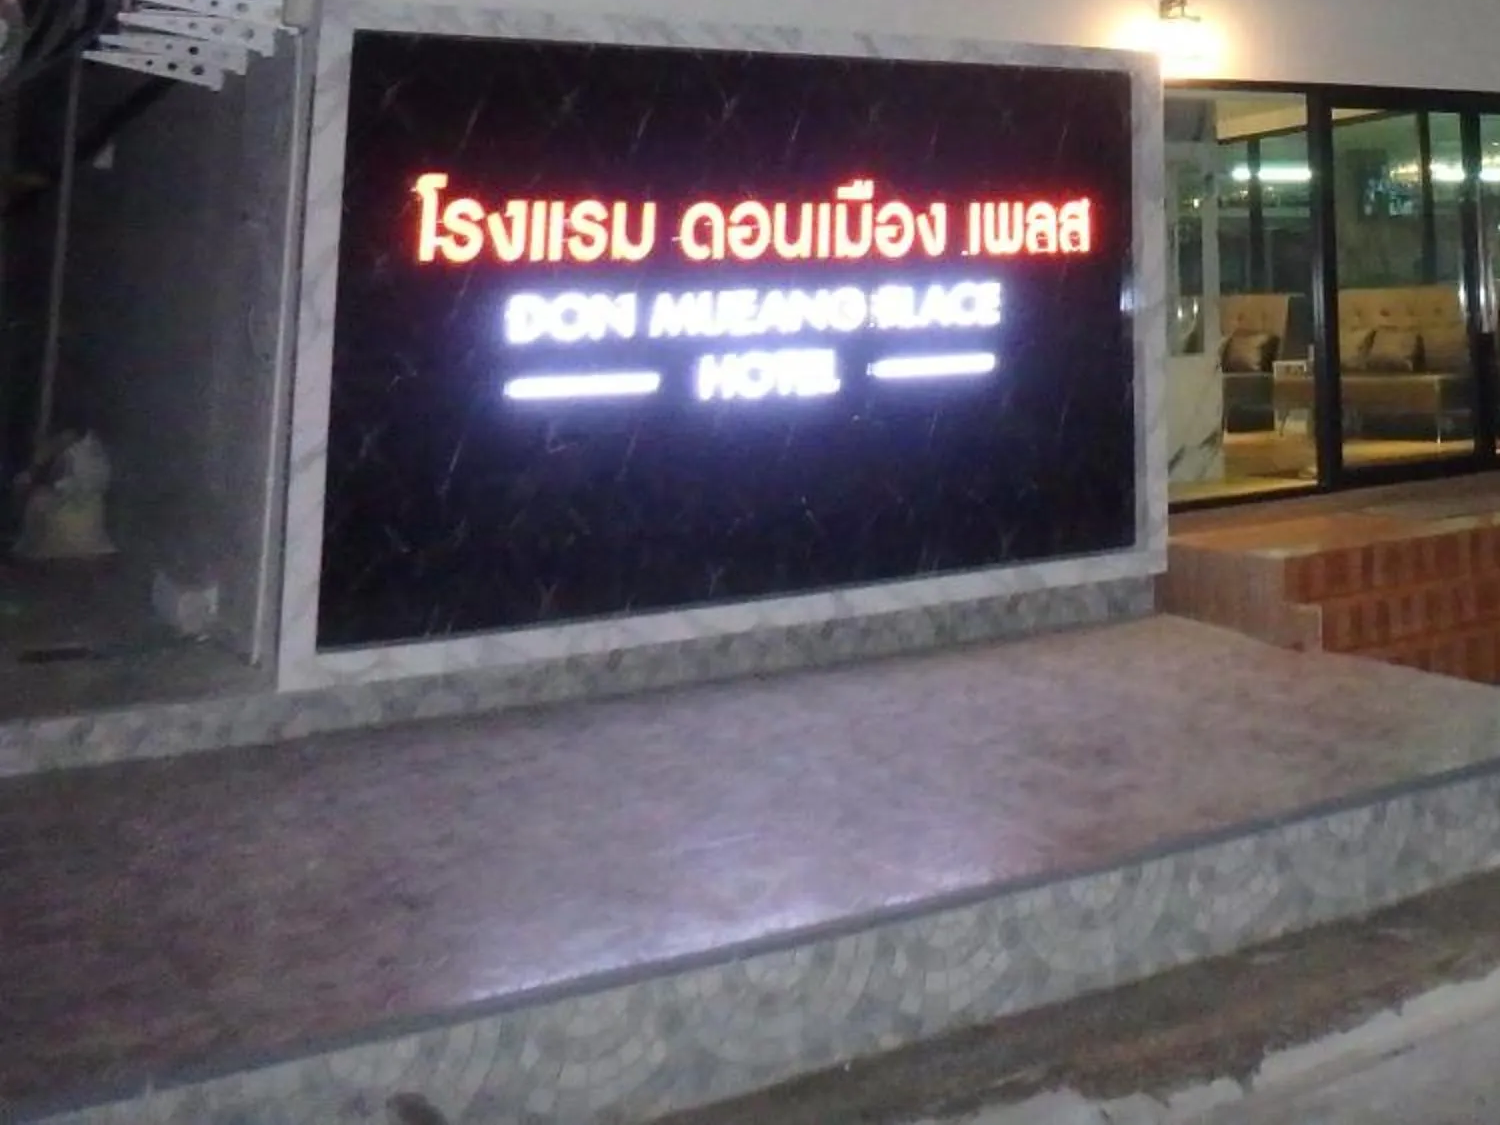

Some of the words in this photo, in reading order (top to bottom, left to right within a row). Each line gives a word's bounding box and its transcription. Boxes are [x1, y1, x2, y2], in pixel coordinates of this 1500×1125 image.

[415, 173, 657, 263] โรงแรม
[678, 179, 947, 261] ดอนเมือง
[966, 196, 1091, 256] เพลส
[505, 292, 637, 344] DON
[697, 349, 840, 400] HOTEL
